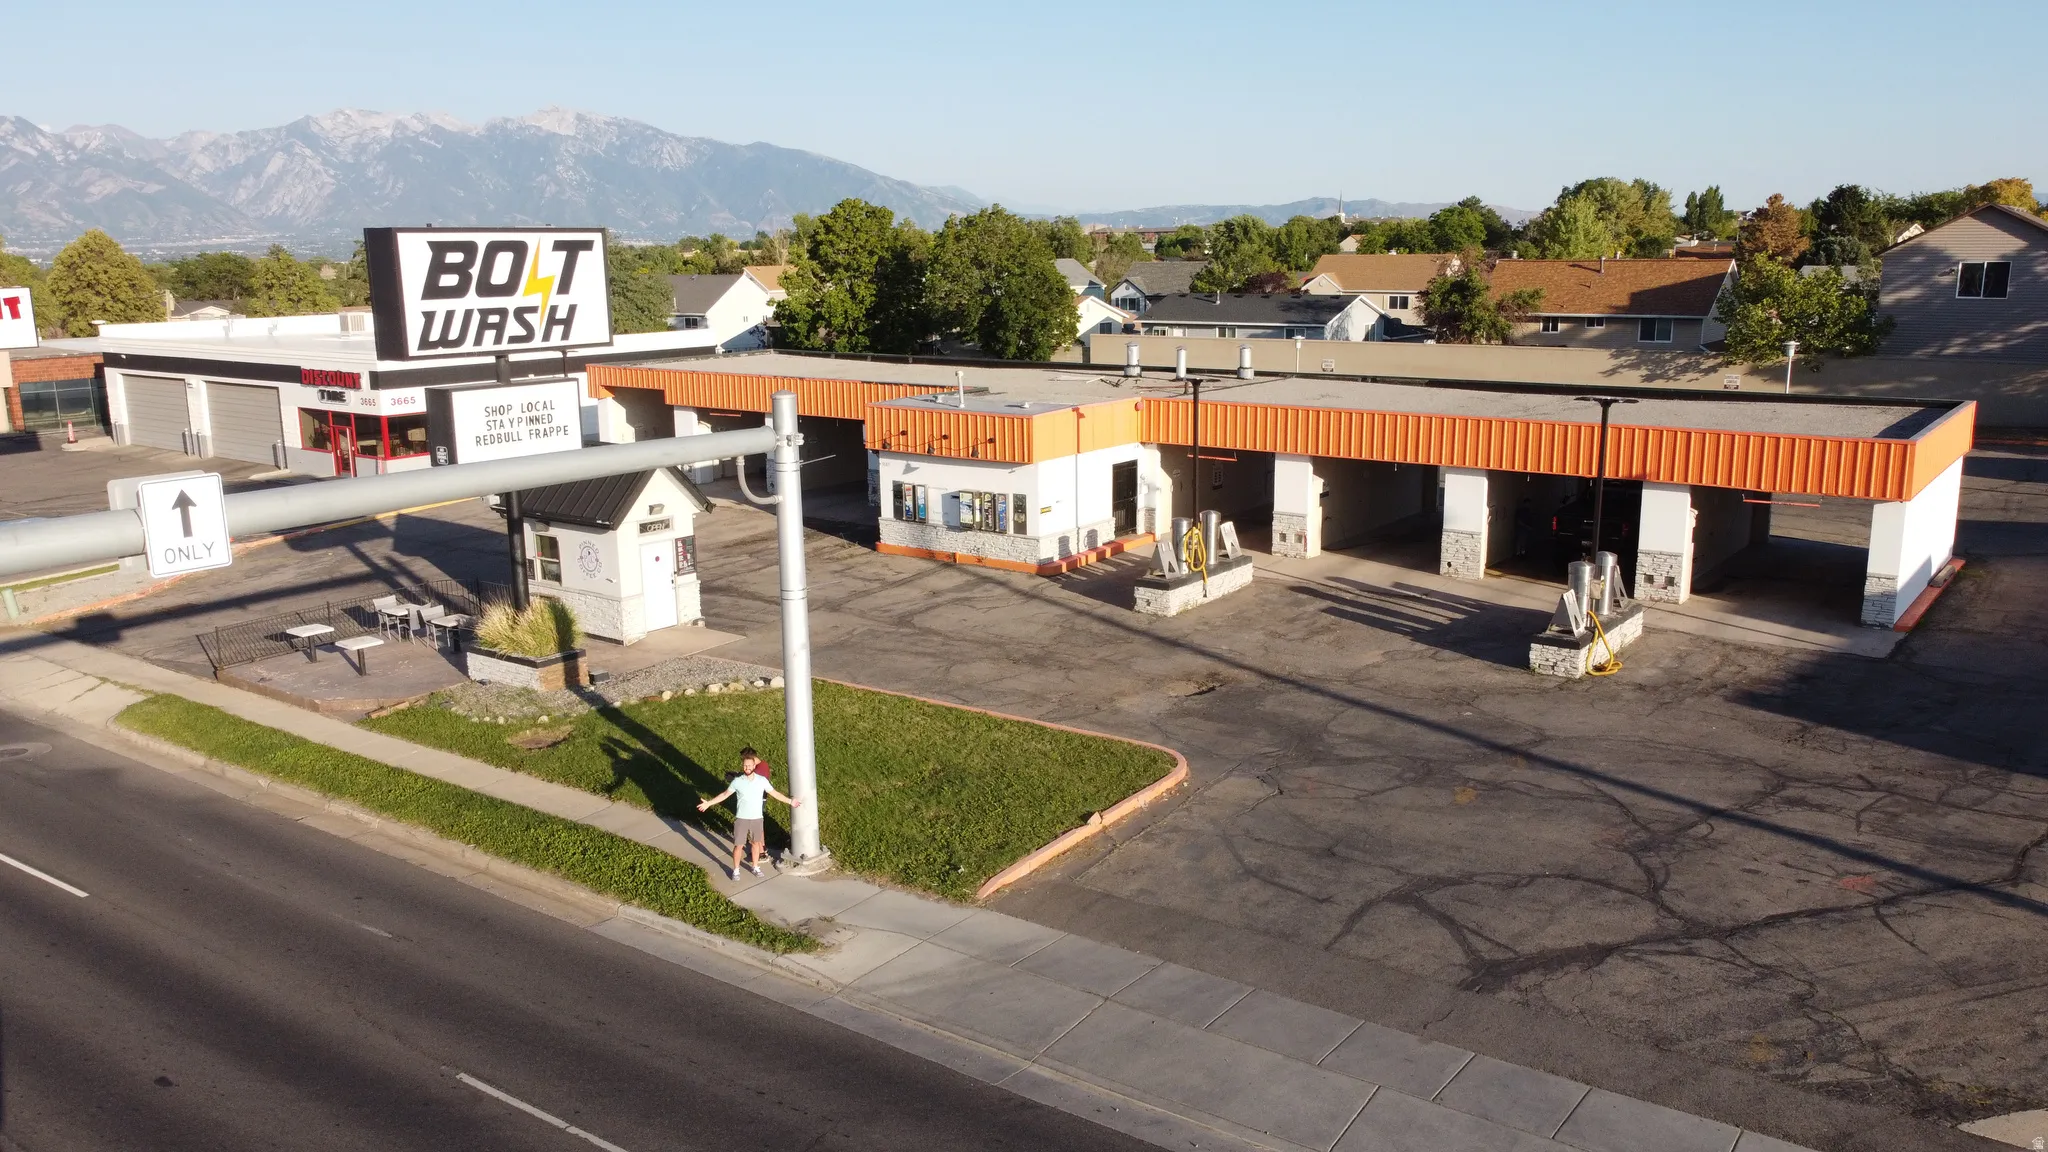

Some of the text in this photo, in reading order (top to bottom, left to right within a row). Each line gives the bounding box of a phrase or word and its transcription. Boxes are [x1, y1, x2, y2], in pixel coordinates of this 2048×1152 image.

[421, 237, 595, 300] BOLT
[417, 303, 578, 351] WASH
[301, 368, 362, 390] DISCOUNT
[318, 389, 347, 403] TIRE
[360, 398, 377, 407] 3665
[390, 396, 416, 406] 3665
[484, 400, 556, 418] SHOP LOCAL
[475, 425, 569, 447] REDBULL FRAPPE
[646, 523, 666, 532] OPEN
[164, 541, 215, 564] ONLY
